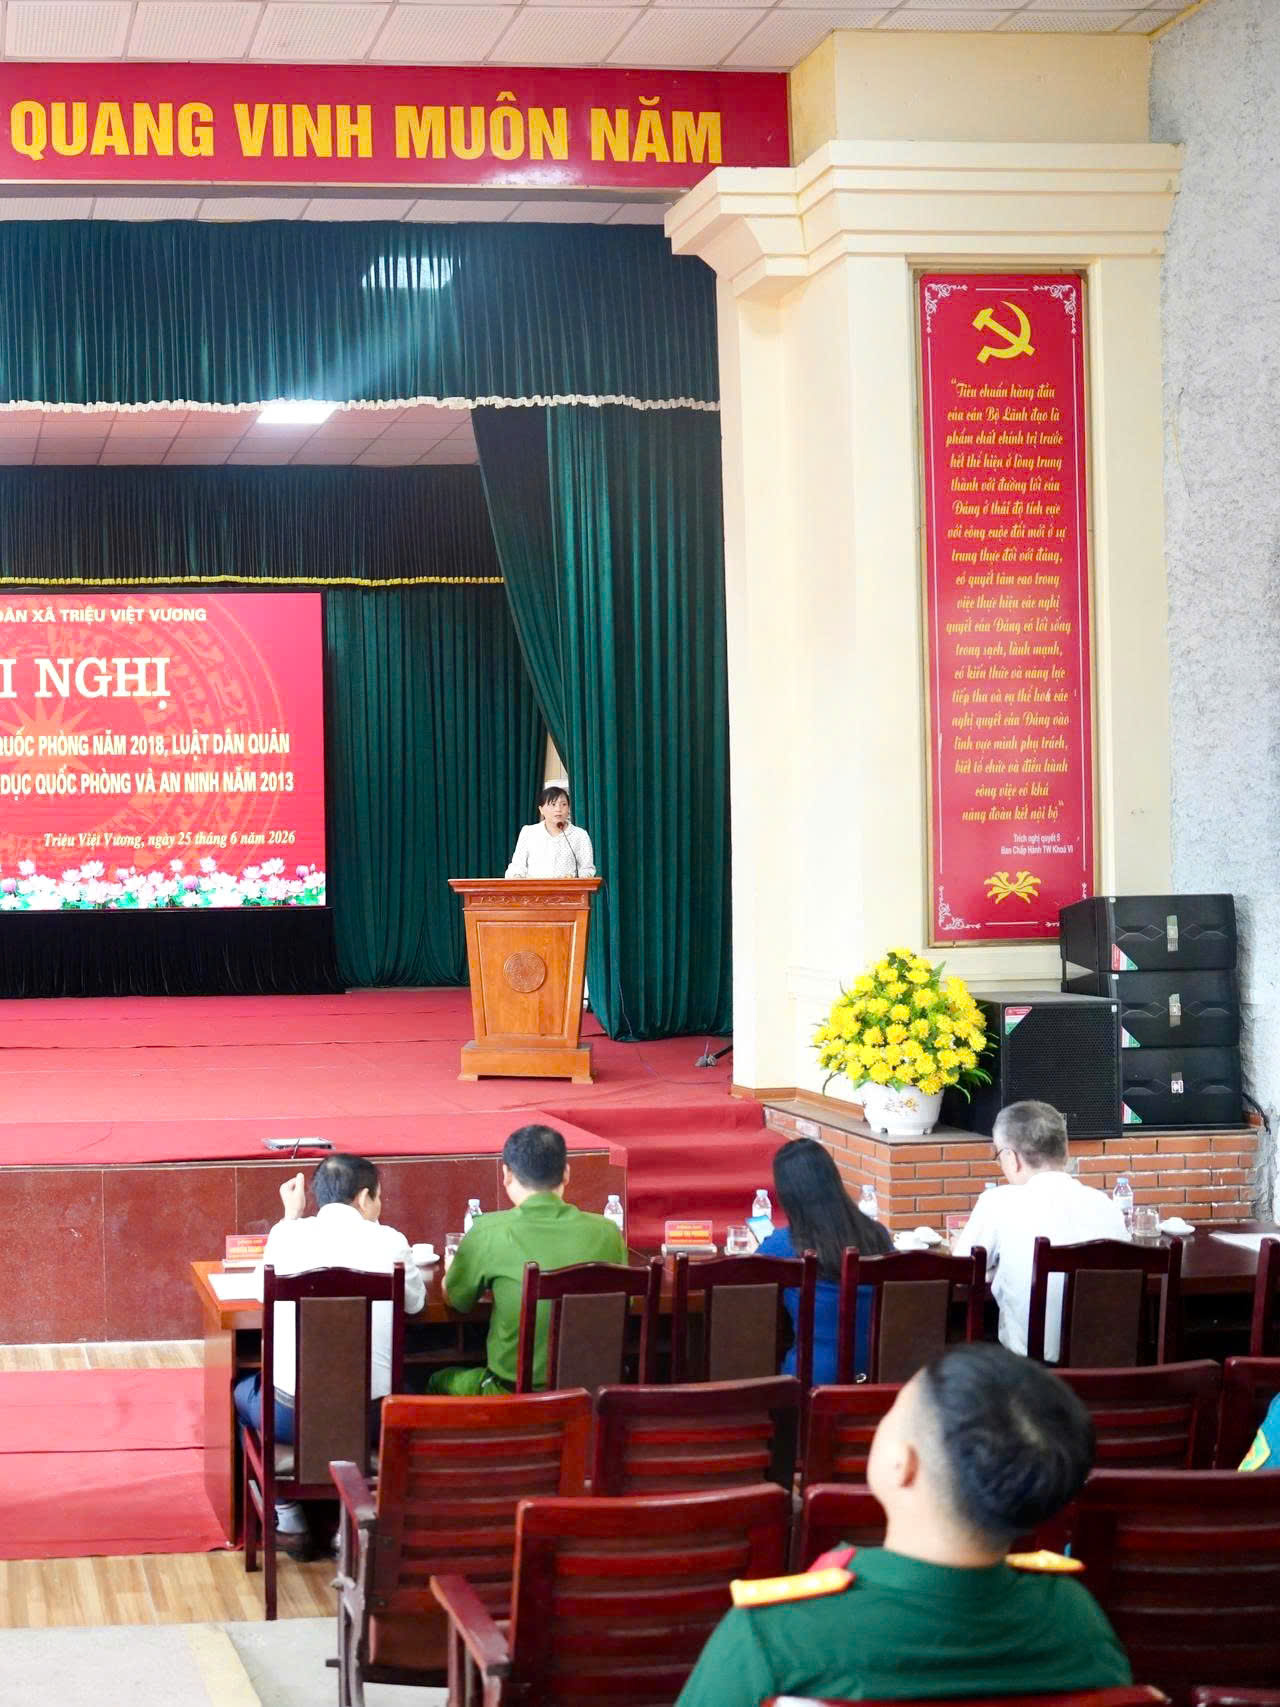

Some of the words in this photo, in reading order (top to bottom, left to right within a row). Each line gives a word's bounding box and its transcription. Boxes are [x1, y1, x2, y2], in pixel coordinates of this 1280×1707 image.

[10, 100, 214, 161] QUANG
[233, 103, 373, 158] VINH
[395, 91, 569, 161] MUÔN
[590, 96, 722, 164] NĂM
[32, 606, 56, 622] XÃ
[60, 606, 106, 624] TRIỆU
[110, 606, 144, 624] VIỆT
[149, 608, 207, 622] VƯƠNG
[35, 657, 170, 710] NGHỊ
[38, 731, 88, 757] PHÒNG
[93, 730, 126, 755] NĂM
[131, 736, 168, 757] 2018,
[172, 729, 208, 761] LUẬT
[213, 728, 244, 754] DÂN
[248, 728, 289, 754] QUÂN
[0, 775, 32, 801] DỤC
[36, 764, 76, 795] QUỐC
[81, 768, 131, 793] PHÒNG
[135, 768, 155, 793] VÀ
[160, 773, 180, 792] AN
[184, 773, 219, 792] NINH
[223, 767, 256, 791] NĂM
[260, 772, 294, 791] 2013
[44, 833, 75, 847] Triệu
[78, 832, 99, 847] Việt
[104, 833, 145, 848] Vương,
[148, 834, 175, 848] ngày
[178, 832, 192, 844] 25
[195, 832, 227, 847] tháng
[230, 831, 237, 844] 6
[240, 831, 264, 844] năm
[269, 831, 296, 844] 2026
